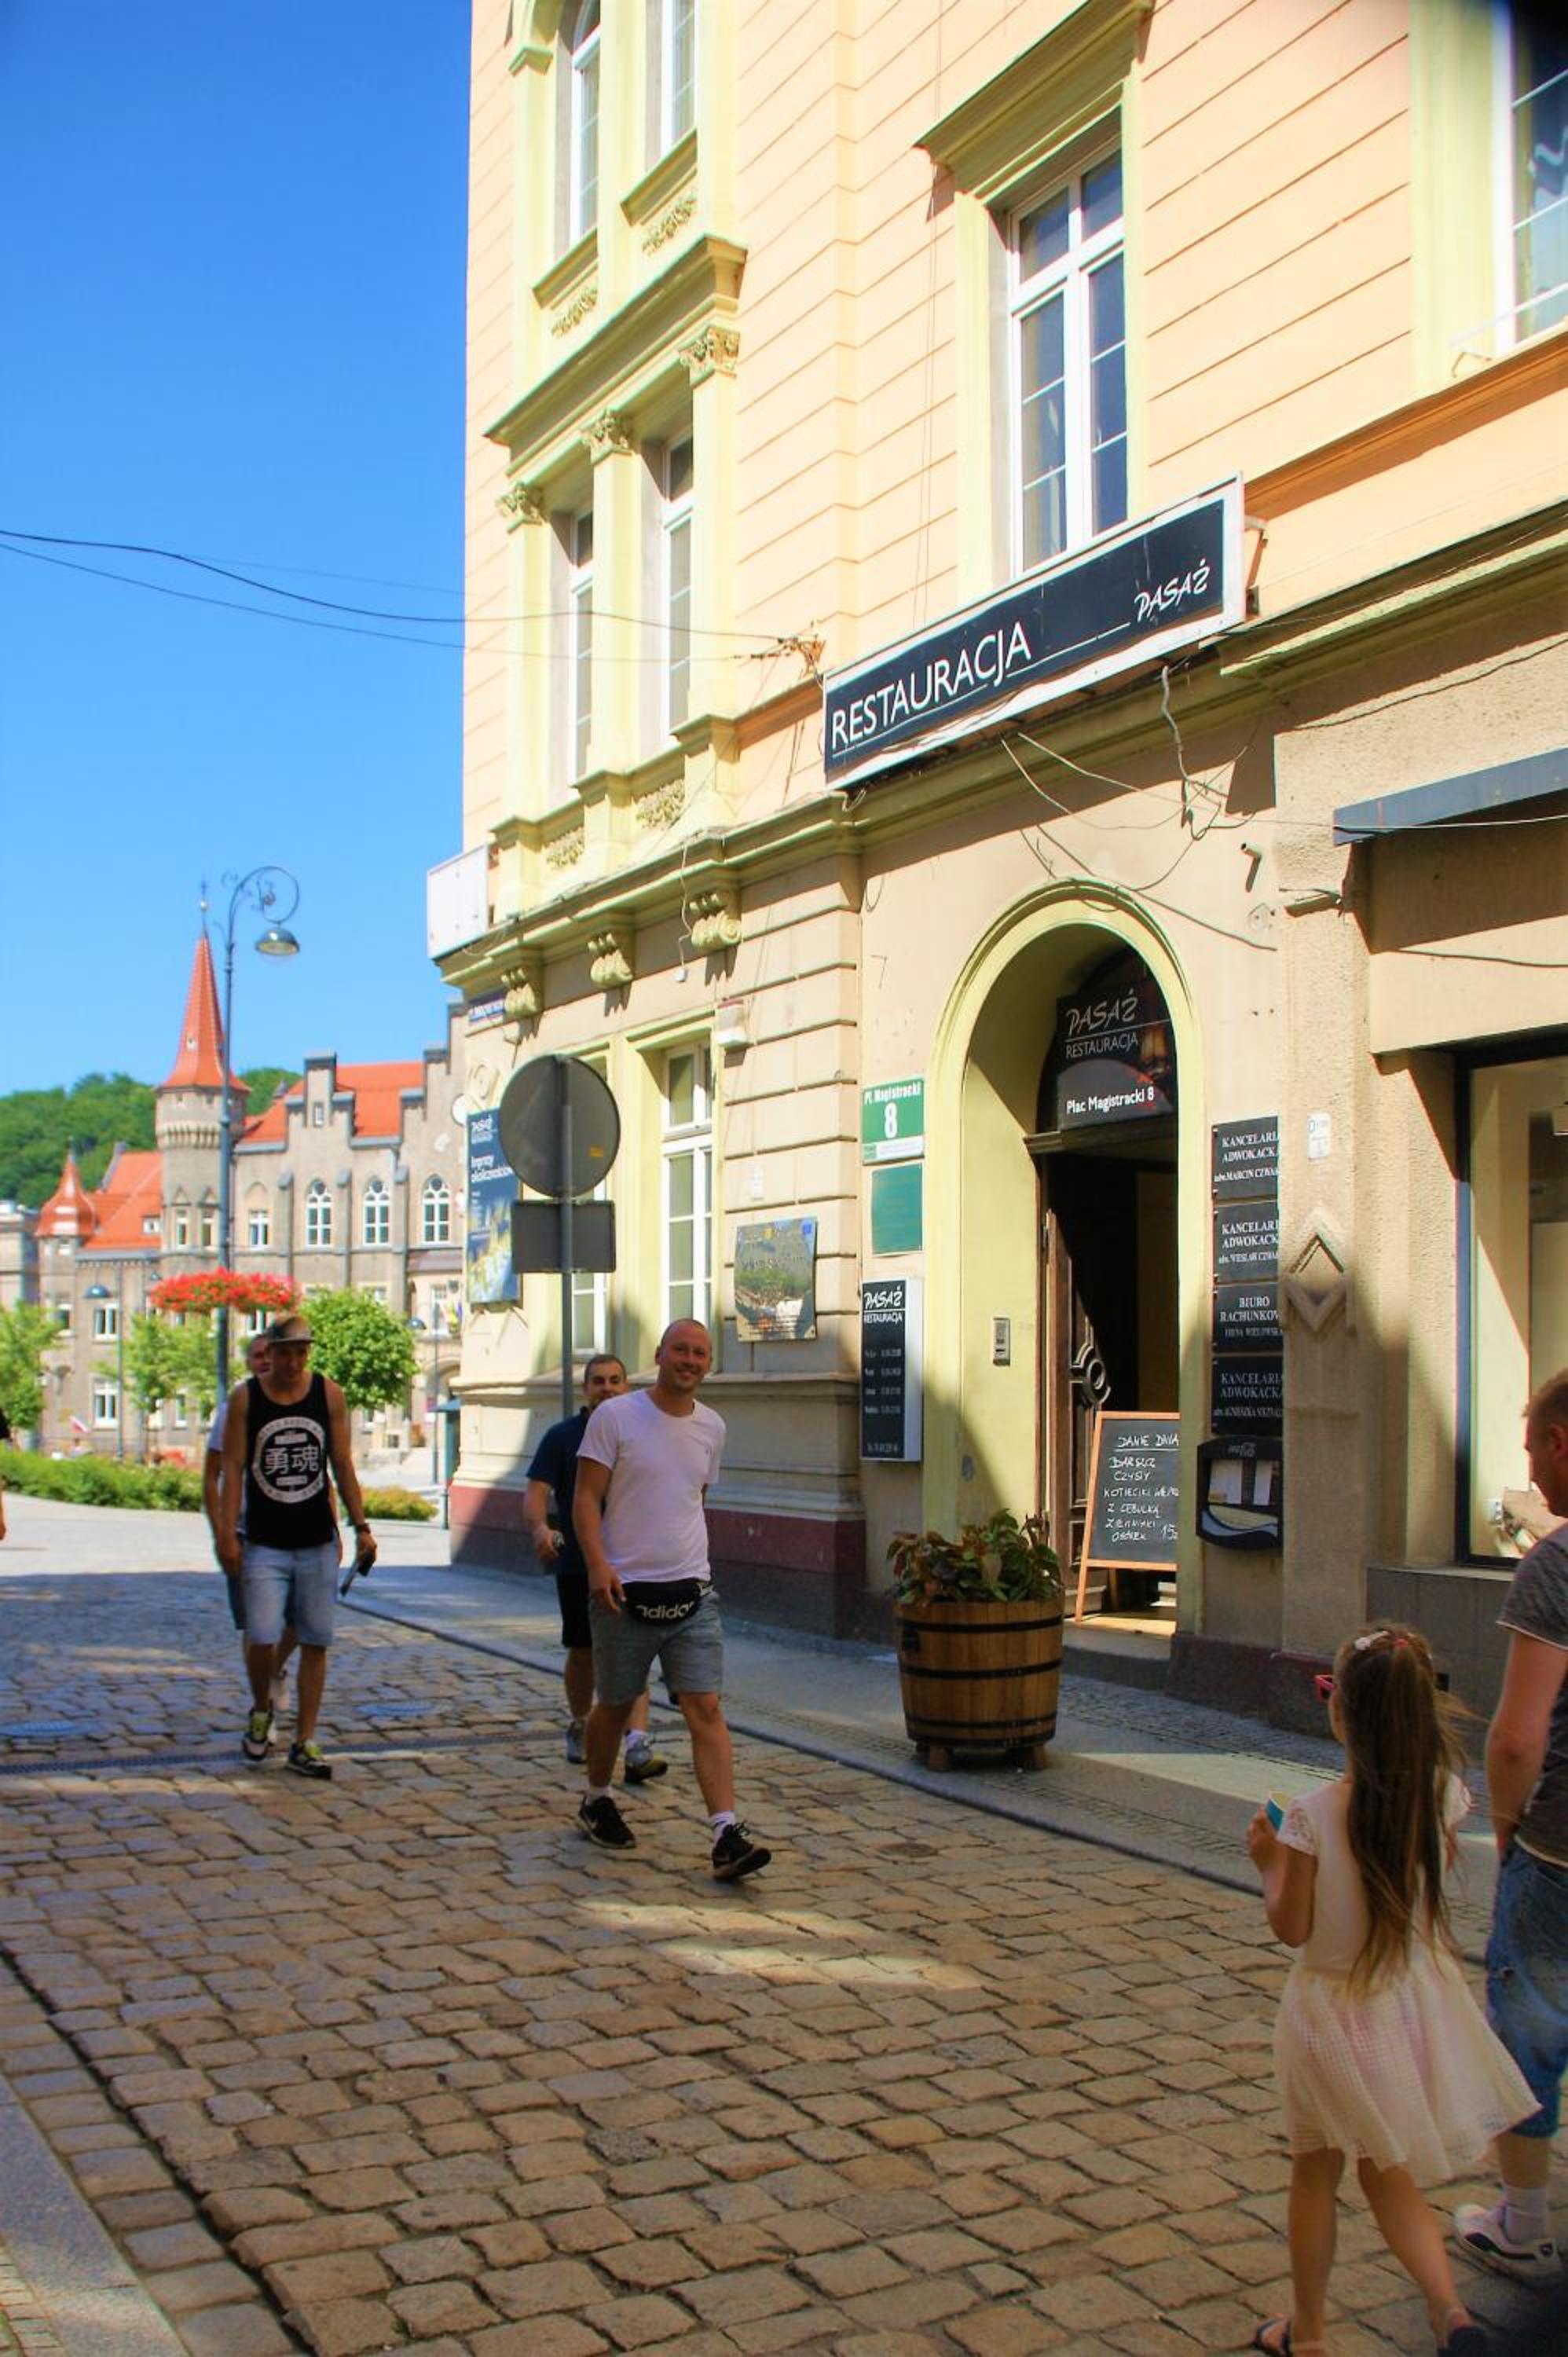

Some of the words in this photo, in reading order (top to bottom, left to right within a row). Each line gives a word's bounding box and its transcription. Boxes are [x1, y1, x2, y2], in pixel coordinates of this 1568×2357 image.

[1134, 559, 1211, 622] PASAŻ
[831, 621, 1031, 750] RESTAURACJA
[1066, 988, 1138, 1036] PASAŻ
[1065, 1032, 1139, 1059] RESTAURACJA
[1067, 1099, 1086, 1114] Plac
[1088, 1088, 1145, 1113] Magistracki
[1147, 1086, 1154, 1102] 8
[885, 1102, 898, 1138] 8
[1222, 1131, 1278, 1147] KANCELARI
[1222, 1147, 1278, 1163] ADWOKACK
[1222, 1219, 1279, 1234] KANCELARI
[1222, 1233, 1279, 1248] ADWOKACK
[863, 1285, 903, 1310] PASAŻ
[1239, 1296, 1270, 1307] BIURO
[863, 1311, 903, 1325] RESTAURACJA
